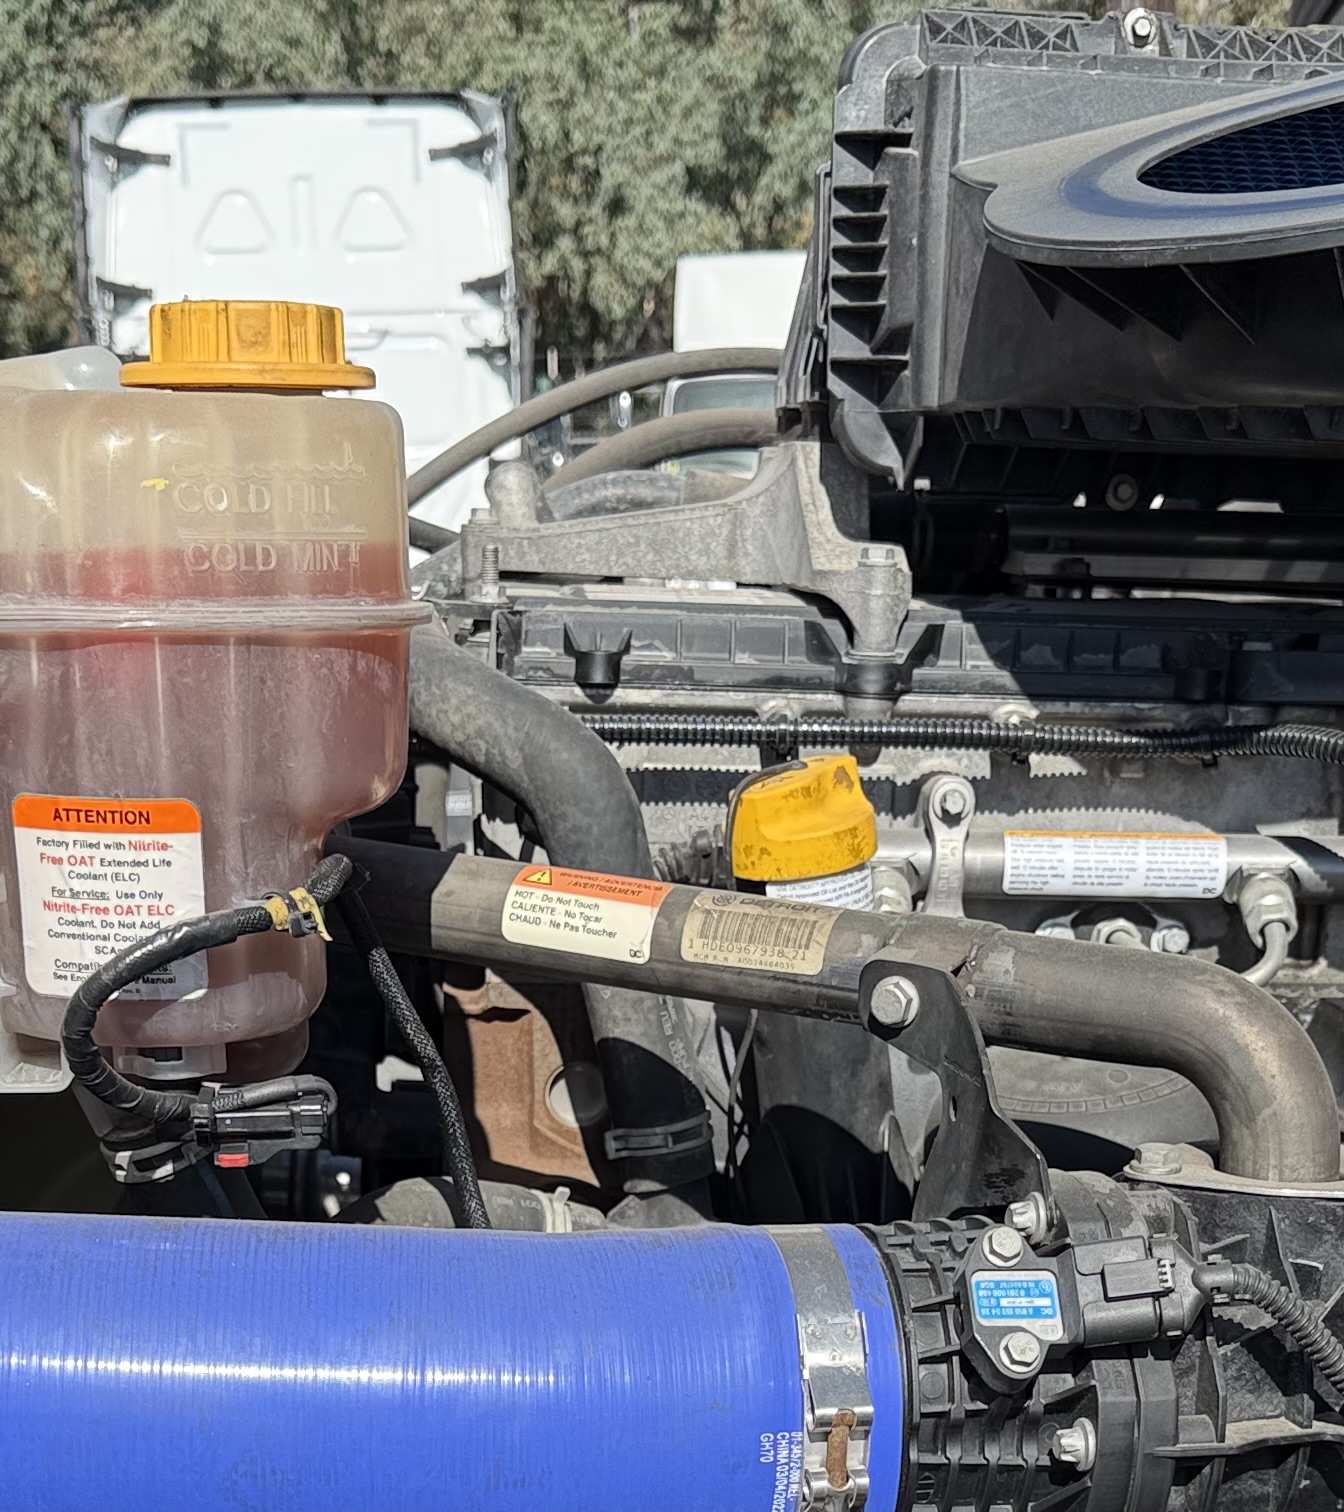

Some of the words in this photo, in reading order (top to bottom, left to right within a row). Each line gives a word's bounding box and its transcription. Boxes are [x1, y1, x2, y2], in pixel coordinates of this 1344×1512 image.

[173, 481, 271, 514] COLD
[183, 543, 277, 573] COLD
[53, 807, 151, 826] ATTENTION
[36, 836, 70, 851] Factory
[72, 839, 100, 850] Filled
[103, 840, 126, 851] with
[128, 840, 174, 852] Nitrite-
[39, 853, 63, 866] Free
[67, 855, 96, 867] OAT
[99, 857, 149, 868] Extended
[152, 858, 172, 868] Life
[68, 870, 108, 882] Coolant
[110, 871, 141, 884] (ELC)
[51, 886, 66, 898] For
[69, 888, 110, 900] Service:
[116, 889, 136, 900] Use
[139, 889, 164, 901] Only
[514, 890, 534, 900] HOT
[541, 894, 554, 903] Do
[556, 896, 572, 906] Not
[574, 899, 600, 911] Touch
[43, 901, 110, 916] Nitrite-Free
[114, 904, 142, 917] OAT
[147, 904, 175, 917] ELC
[511, 901, 556, 916] CALIENTE
[564, 910, 577, 919] No
[579, 913, 604, 924] Tocar
[740, 898, 822, 913] DETROIT
[100, 918, 115, 929] Do
[118, 919, 137, 930] Not
[139, 920, 161, 930] Add
[509, 913, 541, 926] CHAUD
[549, 919, 561, 929] Ne
[563, 921, 579, 933] Pas
[582, 925, 618, 939] Toucher
[47, 929, 111, 943] Conventional
[792, 949, 807, 961] 21
[53, 972, 69, 981] See
[142, 975, 177, 984] Manual
[760, 1432, 774, 1463] GH70
[776, 1432, 789, 1464] CHINA
